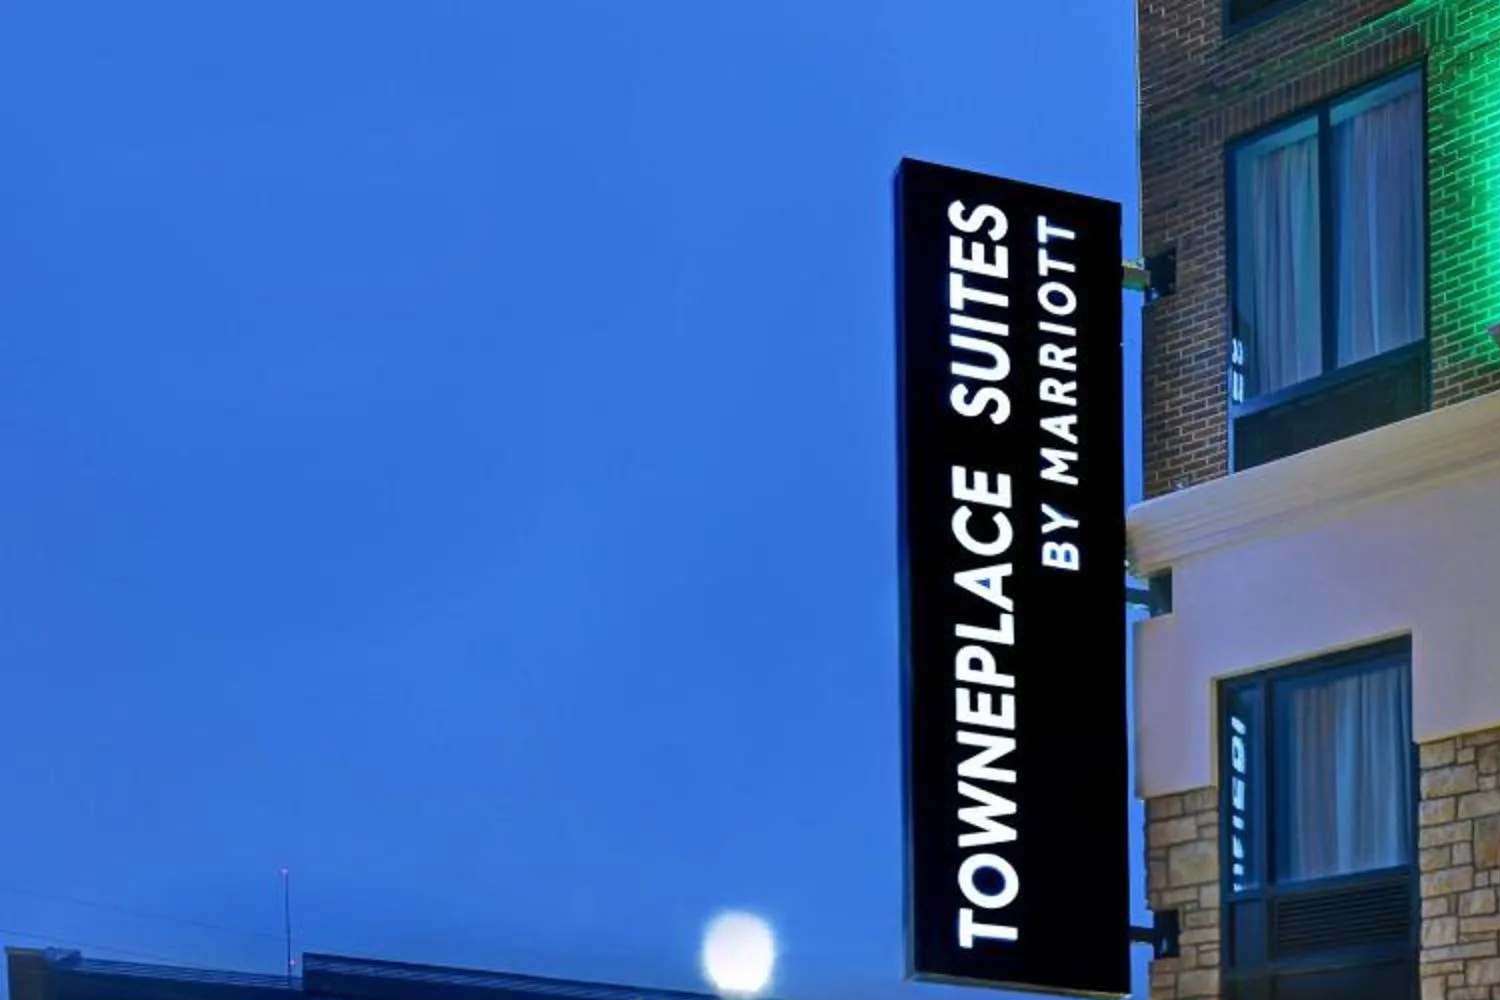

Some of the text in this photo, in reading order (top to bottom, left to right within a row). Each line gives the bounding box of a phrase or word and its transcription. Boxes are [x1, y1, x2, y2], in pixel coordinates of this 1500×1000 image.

[947, 199, 1020, 949] TOWNEPLACE SUITES
[1037, 215, 1080, 571] BY MARRIOTT
